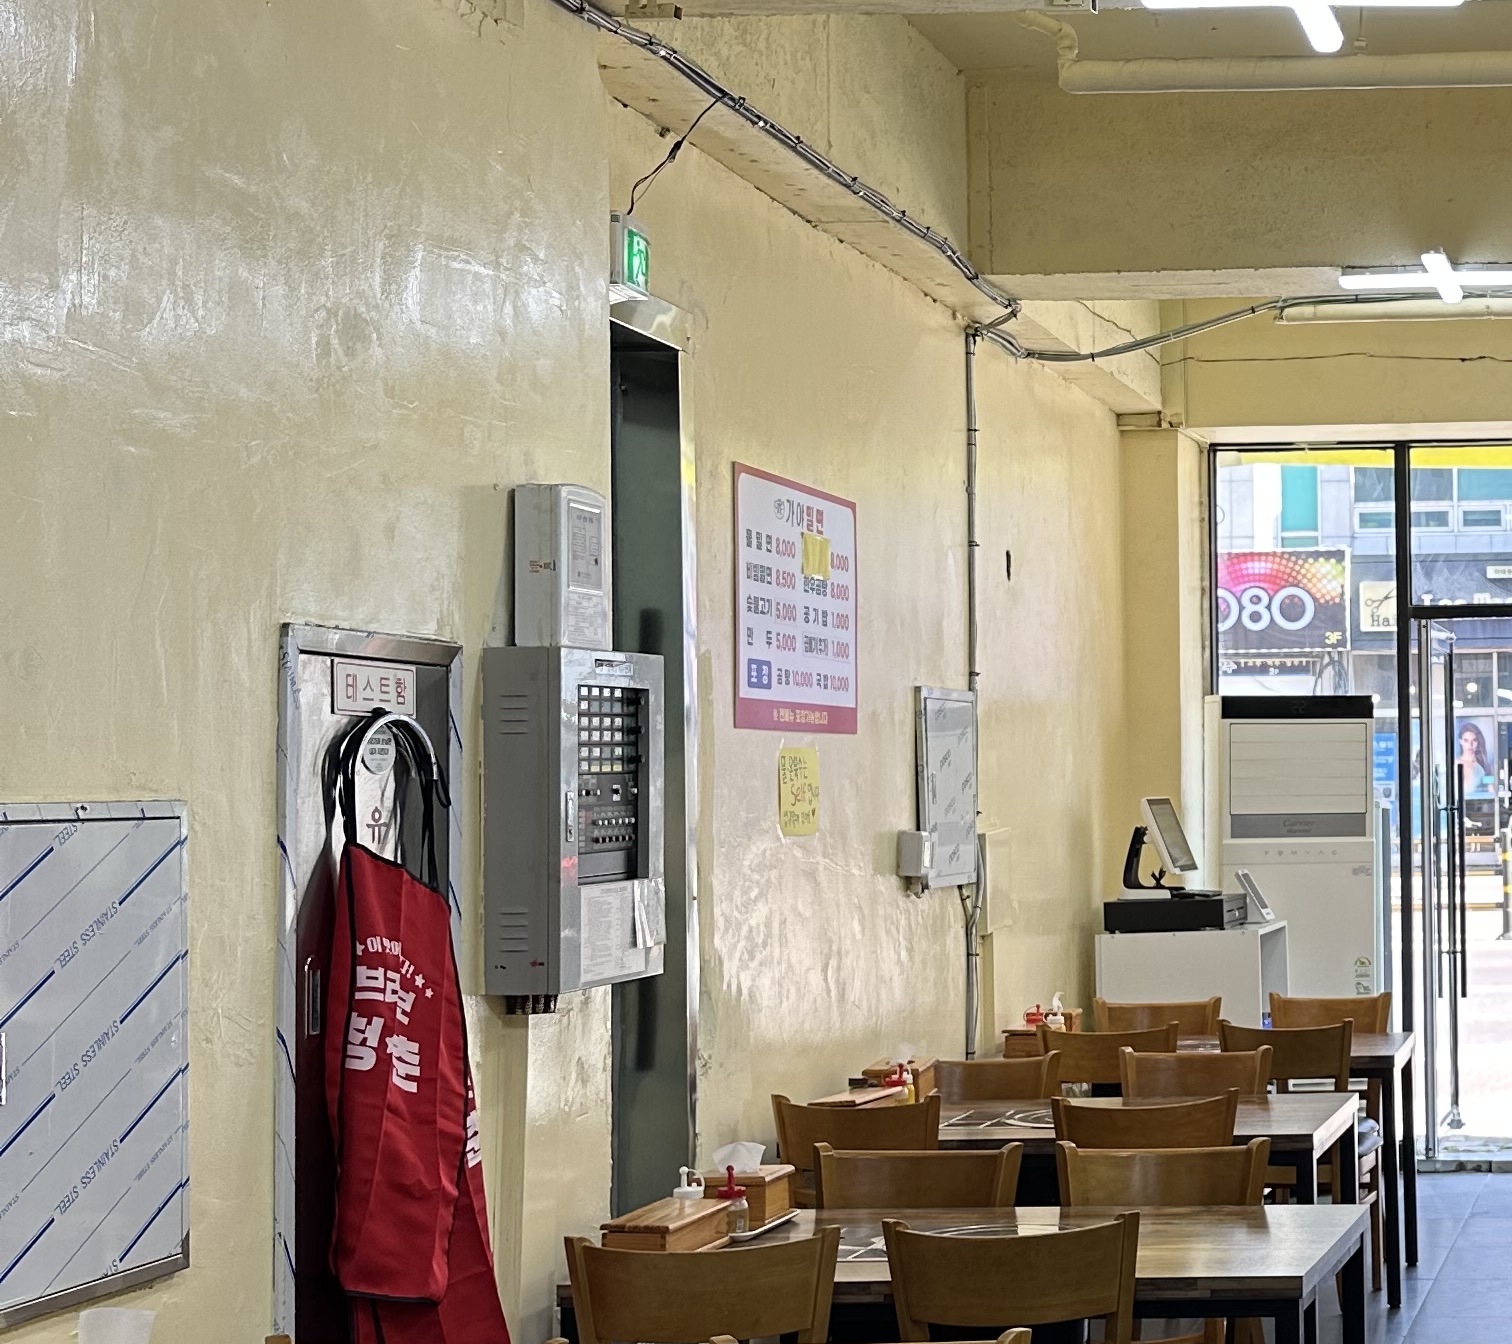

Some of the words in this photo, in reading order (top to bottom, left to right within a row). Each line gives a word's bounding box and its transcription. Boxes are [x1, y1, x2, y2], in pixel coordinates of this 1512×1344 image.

[785, 498, 824, 534] 가야밀면
[774, 535, 796, 560] 8,000
[829, 550, 849, 573] 8,000
[775, 568, 796, 591] 8,500
[829, 580, 849, 602] 8,000
[775, 600, 797, 623] 5,000
[831, 611, 849, 631] 1,000
[775, 631, 796, 653] 5,000
[831, 639, 850, 660] 1,000
[1324, 631, 1343, 644] 3F
[345, 672, 407, 706] 테스트함
[791, 669, 813, 689] 10,000
[829, 674, 849, 693] 10,000
[80, 901, 118, 947] STAINLESS
[56, 940, 80, 969] STEEL
[81, 1019, 120, 1067] STAINLESS
[57, 1062, 81, 1091] STEEL
[80, 1138, 120, 1189] STAINLESS
[56, 1184, 80, 1216] STEEL
